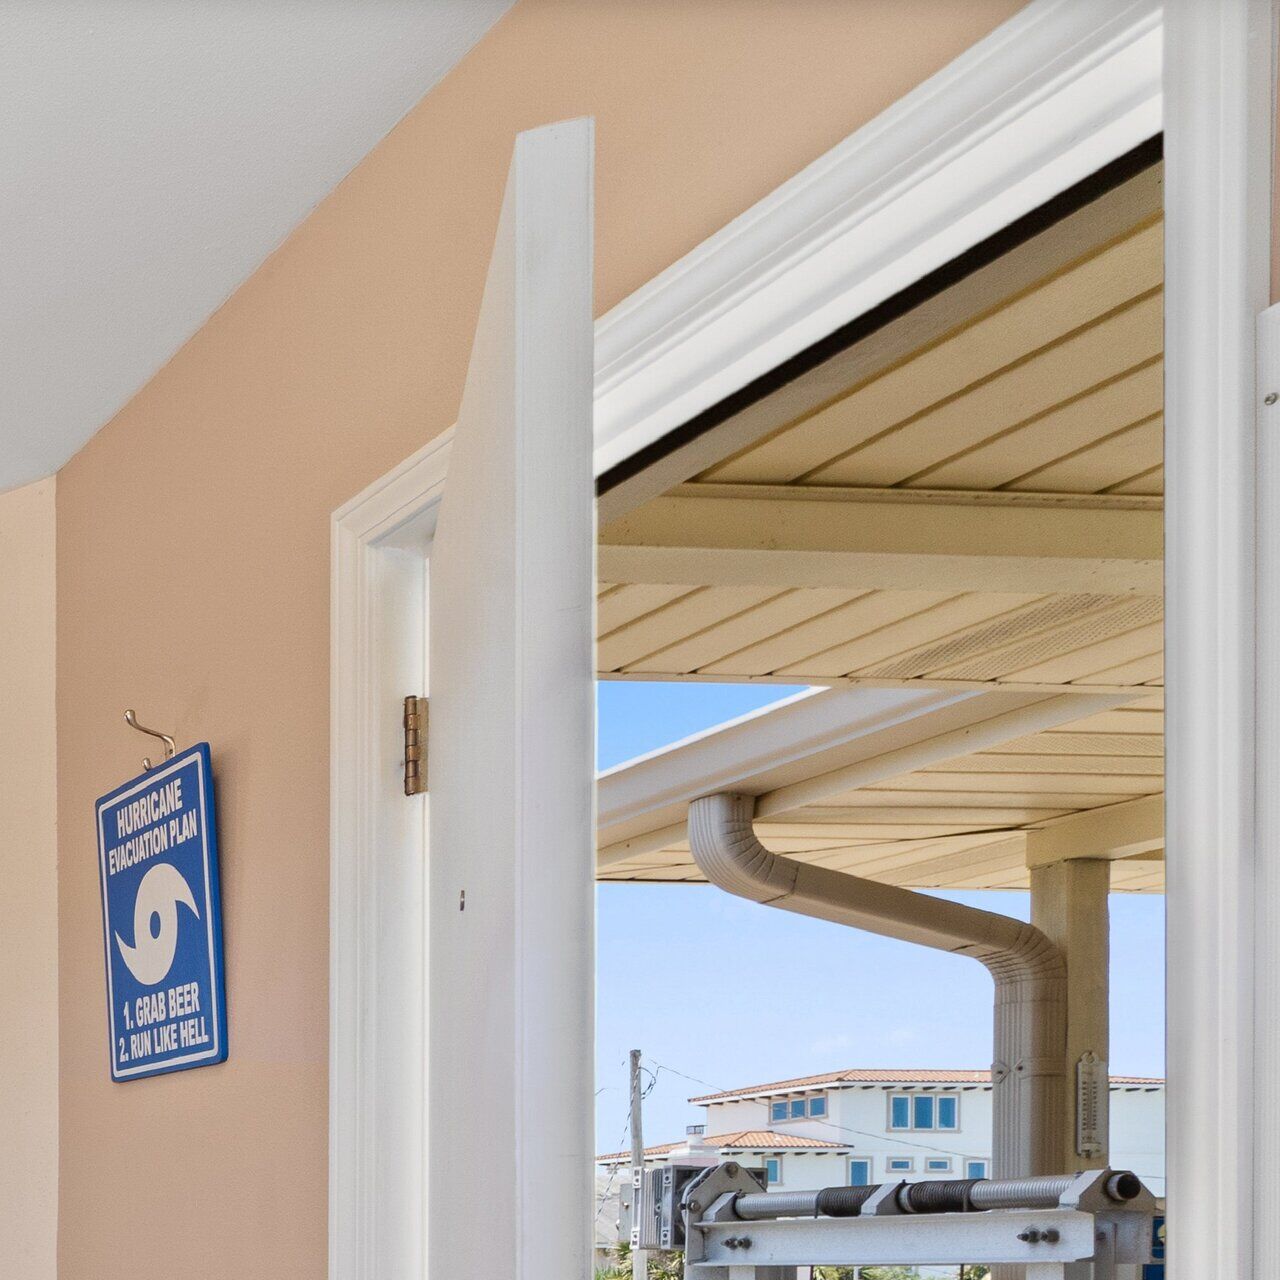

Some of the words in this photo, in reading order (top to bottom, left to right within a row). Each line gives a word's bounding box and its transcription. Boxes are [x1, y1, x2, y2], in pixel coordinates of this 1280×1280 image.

[117, 778, 183, 839] HURRICANE
[109, 823, 168, 875] EVACUATION
[169, 808, 197, 847] PLAN
[124, 1001, 134, 1030] 1.
[136, 991, 167, 1027] GRAB
[168, 982, 200, 1018] BEER
[119, 1037, 129, 1063] 2.
[130, 1030, 152, 1060] RUN
[153, 1023, 178, 1054] LIKE
[180, 1016, 209, 1048] HELL
